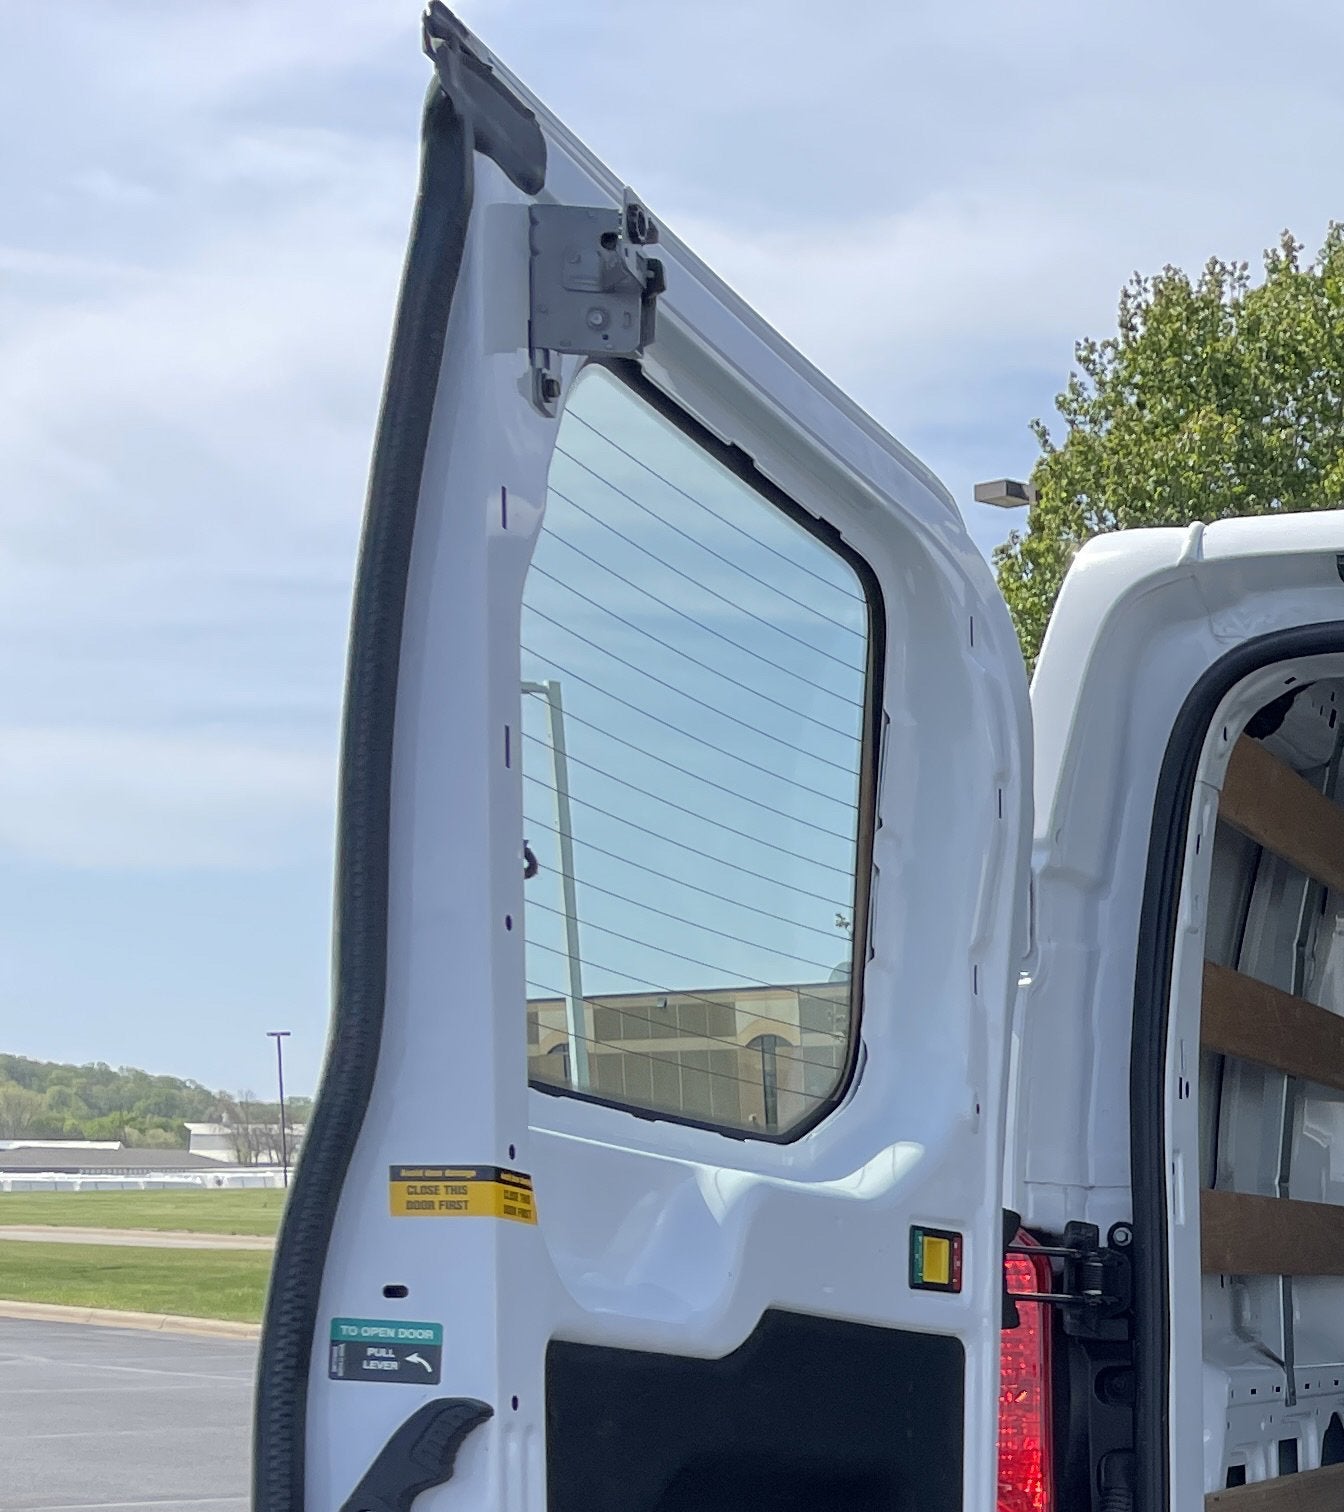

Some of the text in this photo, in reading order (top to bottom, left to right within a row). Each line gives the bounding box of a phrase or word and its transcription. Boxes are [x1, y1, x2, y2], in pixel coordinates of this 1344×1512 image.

[407, 1185, 468, 1195] CLOSE THIS
[406, 1200, 469, 1210] DOOR FIRST
[339, 1325, 434, 1339] TO OPEN DOOR
[366, 1347, 395, 1358] PULL
[362, 1360, 399, 1370] LEVER
